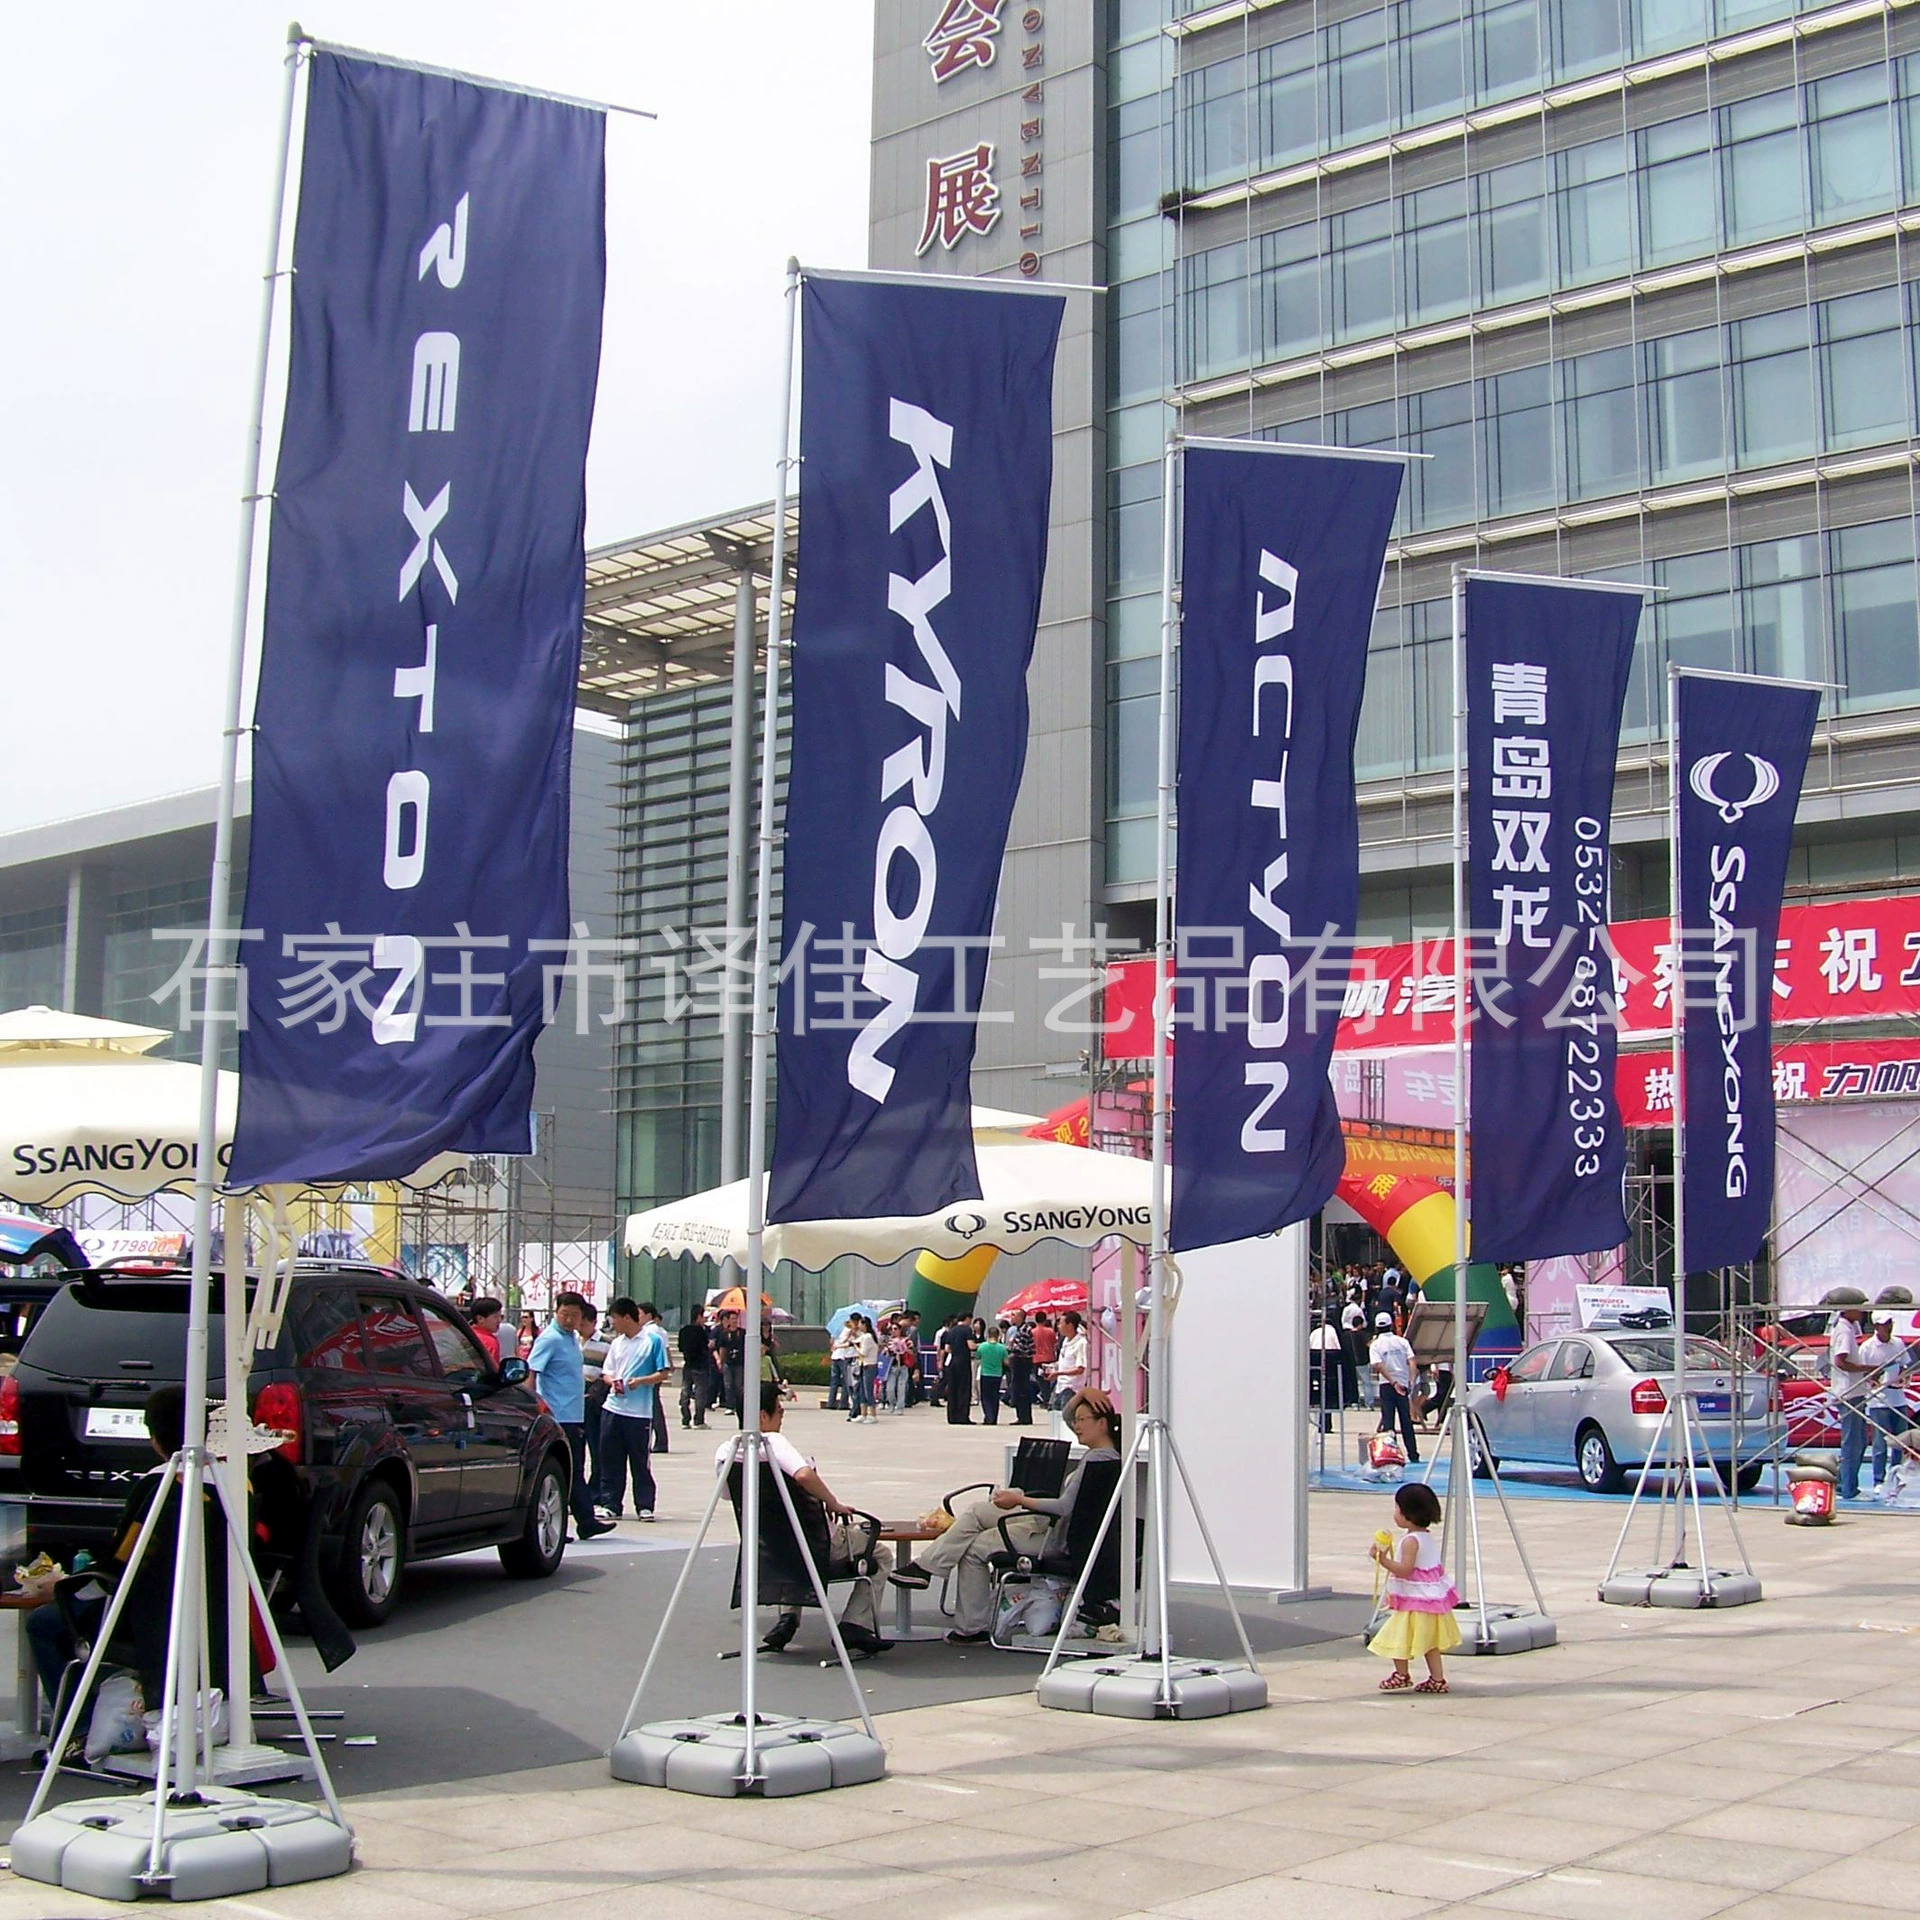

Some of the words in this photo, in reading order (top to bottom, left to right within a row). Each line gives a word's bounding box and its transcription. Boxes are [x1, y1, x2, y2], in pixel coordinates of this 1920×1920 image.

[915, 0, 1003, 257] 会展
[372, 192, 468, 1045] REXTON
[848, 396, 961, 1104] KYRON
[1240, 548, 1299, 1152] ACTYON
[1491, 662, 1551, 949] 青岛双龙
[1567, 815, 1604, 1178] 0532-88722333
[1709, 844, 1747, 1199] SSANGYONG
[1004, 1205, 1151, 1233] SSANGYONG
